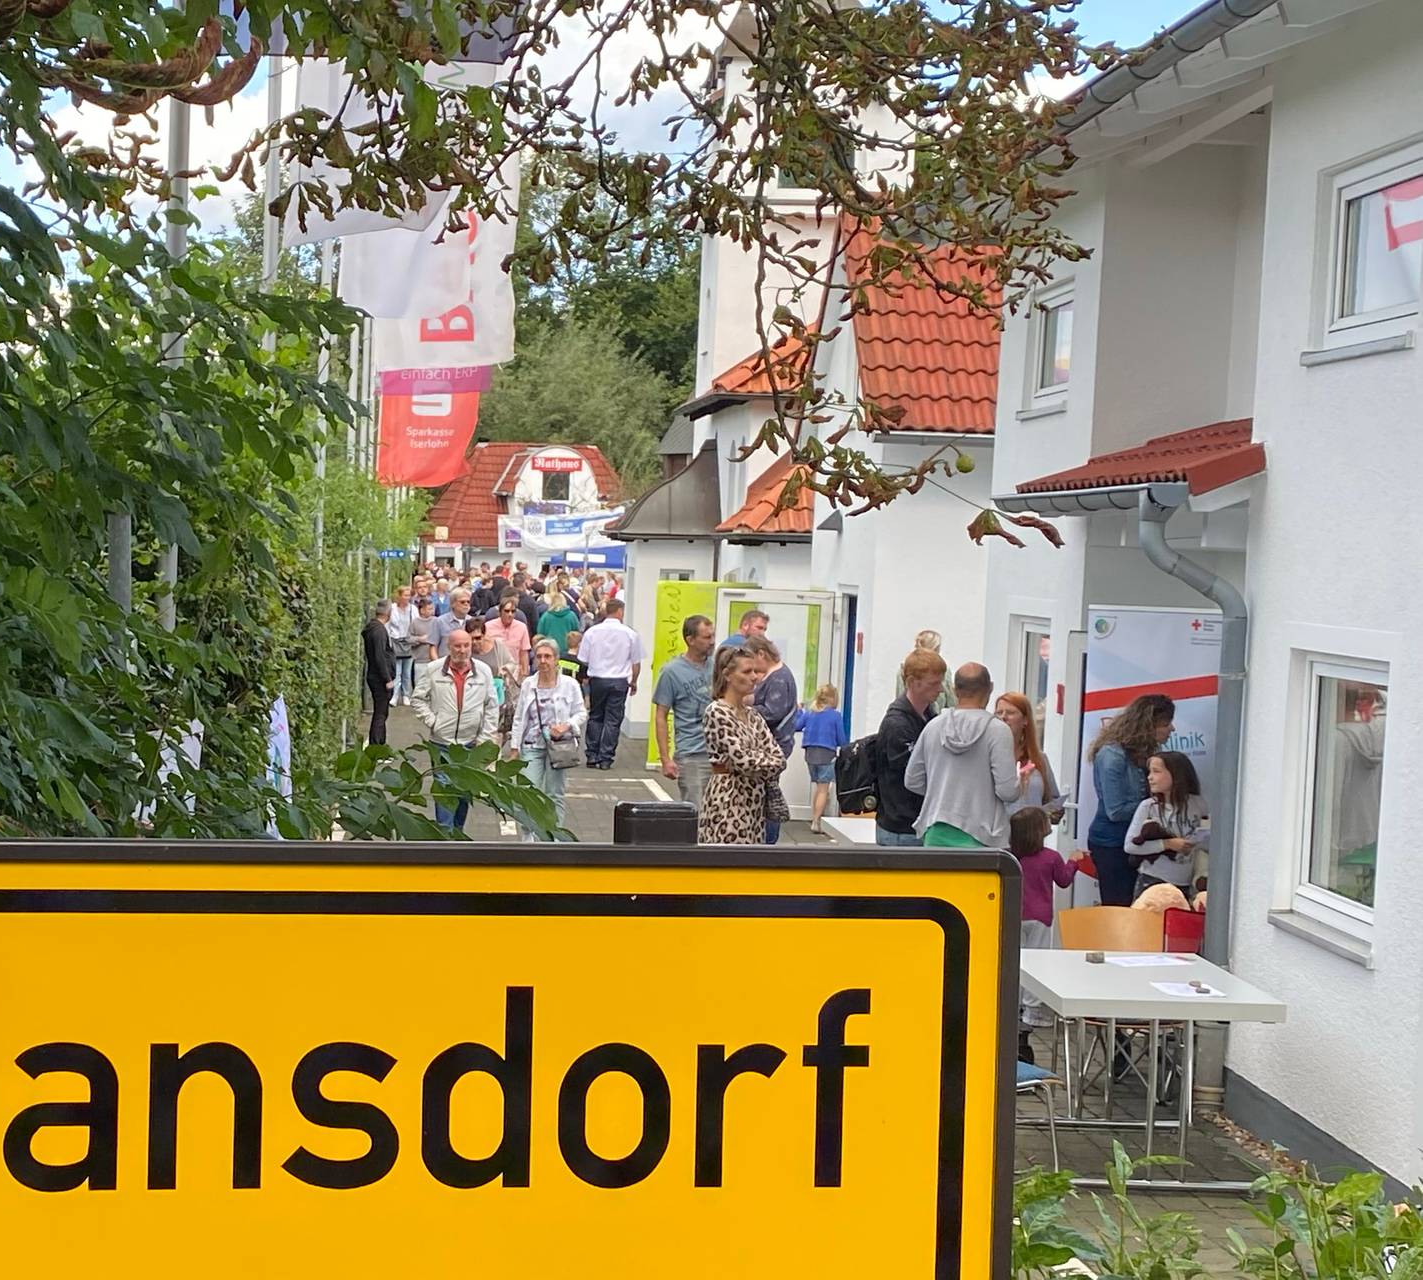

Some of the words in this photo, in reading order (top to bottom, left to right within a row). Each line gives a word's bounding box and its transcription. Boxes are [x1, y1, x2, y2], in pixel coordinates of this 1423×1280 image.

[405, 425, 455, 438] Sparkasse
[409, 439, 450, 449] Iserlohn
[534, 457, 580, 471] Rathaus
